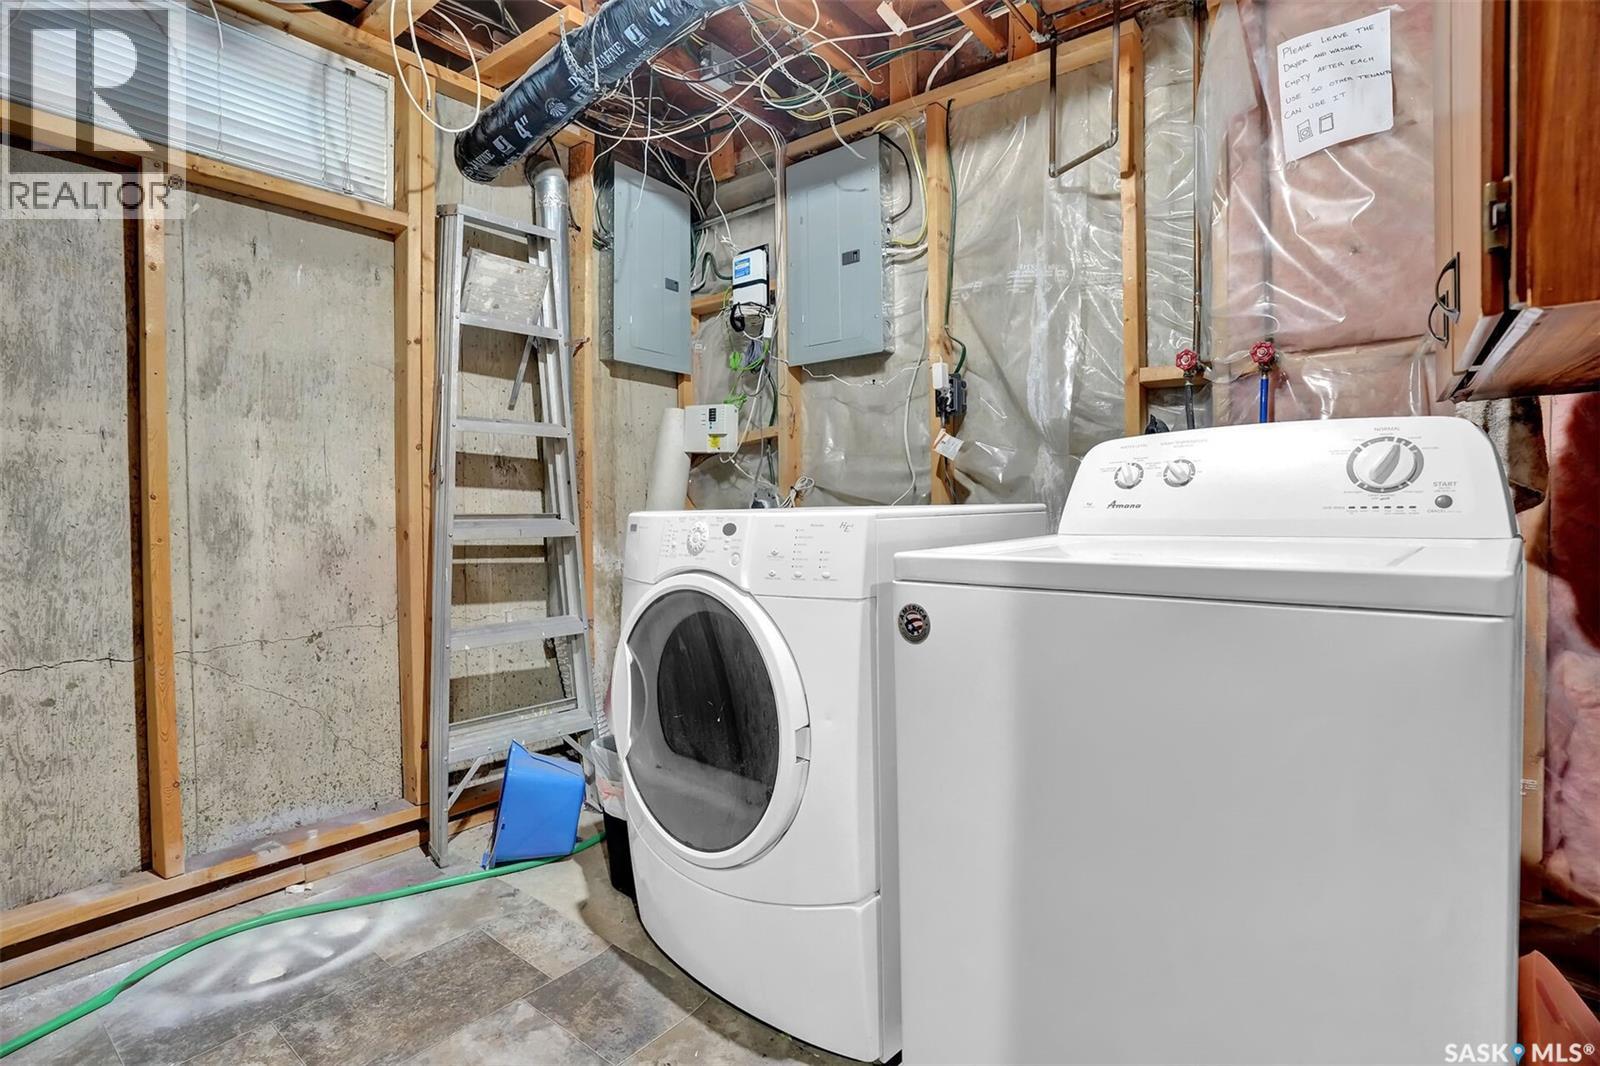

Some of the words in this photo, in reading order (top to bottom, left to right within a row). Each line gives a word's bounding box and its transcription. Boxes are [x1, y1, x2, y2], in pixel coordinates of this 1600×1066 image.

[1321, 32, 1349, 44] LEAVE
[1356, 24, 1375, 34] THE
[596, 41, 626, 69] JAFINE
[1283, 58, 1308, 73] DRYER
[1313, 50, 1327, 60] AND
[1330, 44, 1362, 55] WASHER
[1284, 73, 1311, 89] EMPTY
[1317, 62, 1344, 73] AFTER
[1350, 56, 1375, 65] EACH
[1285, 93, 1301, 105] USE
[1311, 85, 1323, 94] SO
[1329, 77, 1353, 87] OTHER
[1284, 107, 1302, 120] CAN
[1308, 99, 1326, 109] USE
[1333, 91, 1347, 102] IT
[514, 114, 533, 139] 4"
[1106, 500, 1142, 509] Amana
